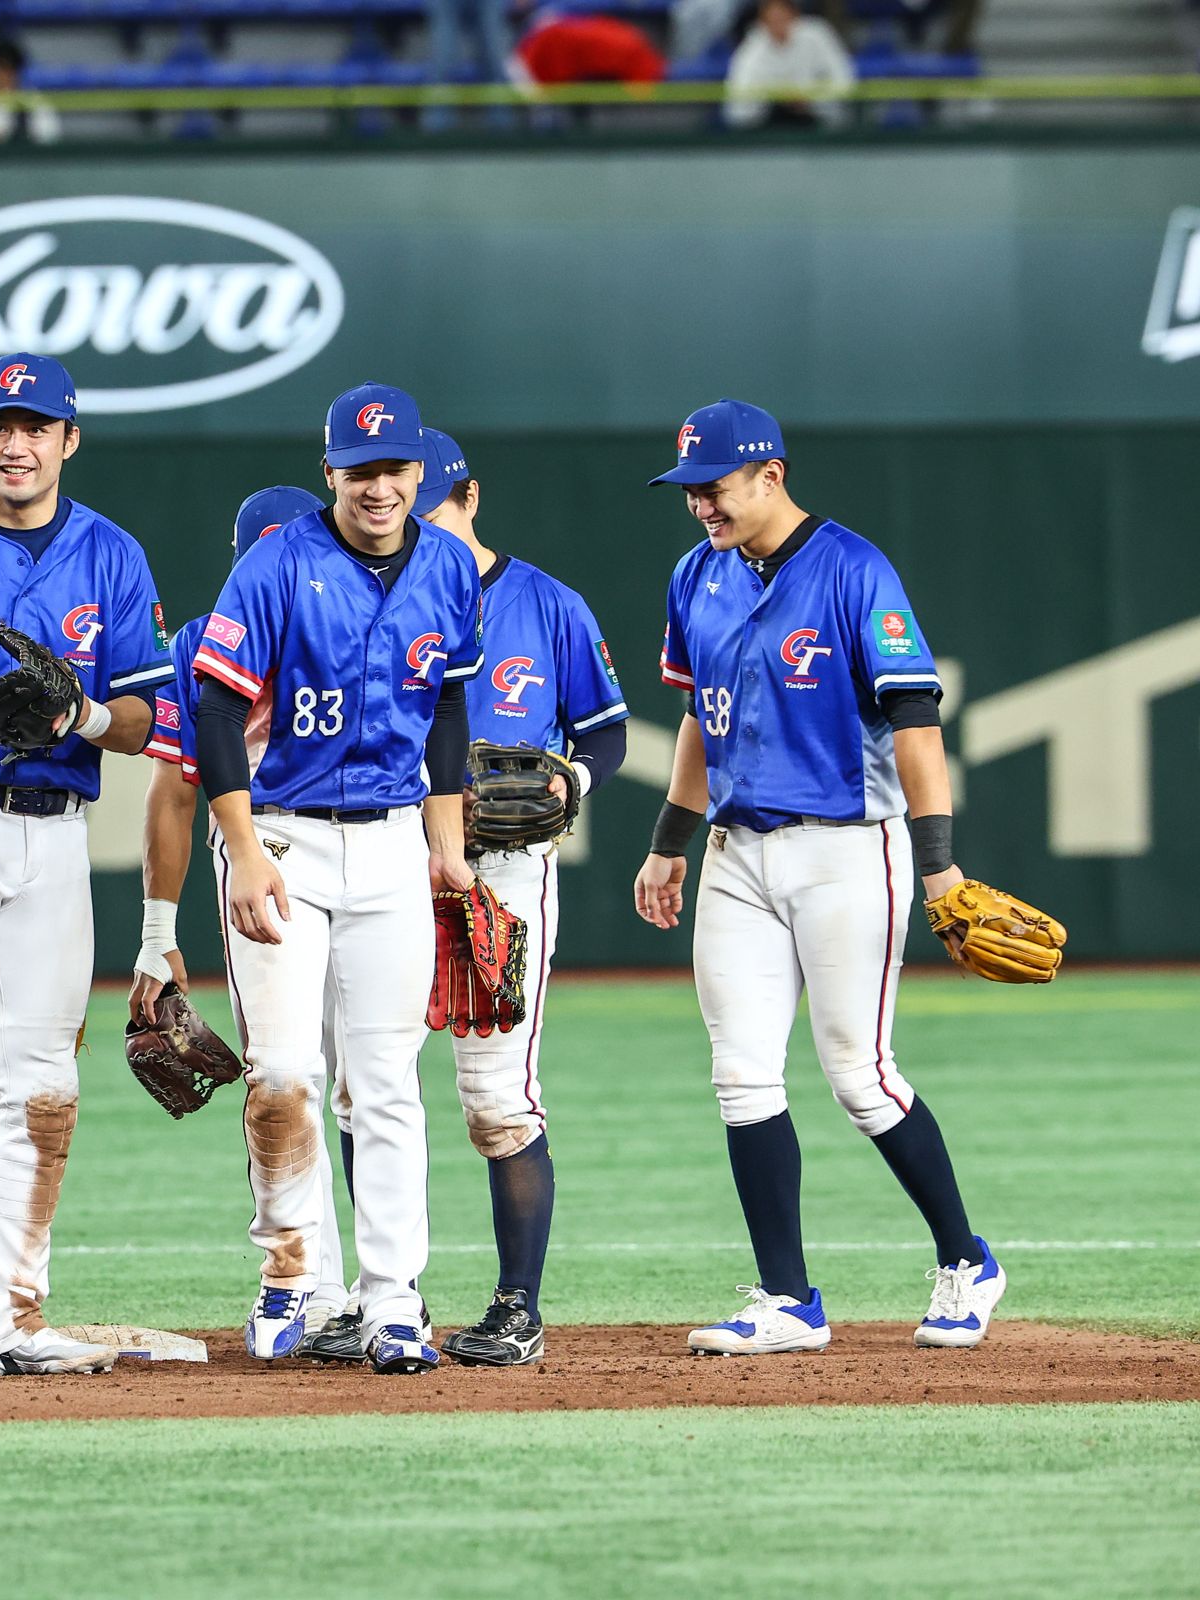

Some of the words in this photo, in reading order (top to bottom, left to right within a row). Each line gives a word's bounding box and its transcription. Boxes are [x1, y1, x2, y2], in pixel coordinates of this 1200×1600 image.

[292, 686, 344, 737] 83
[493, 708, 527, 719] Taipei
[701, 687, 732, 737] 58
